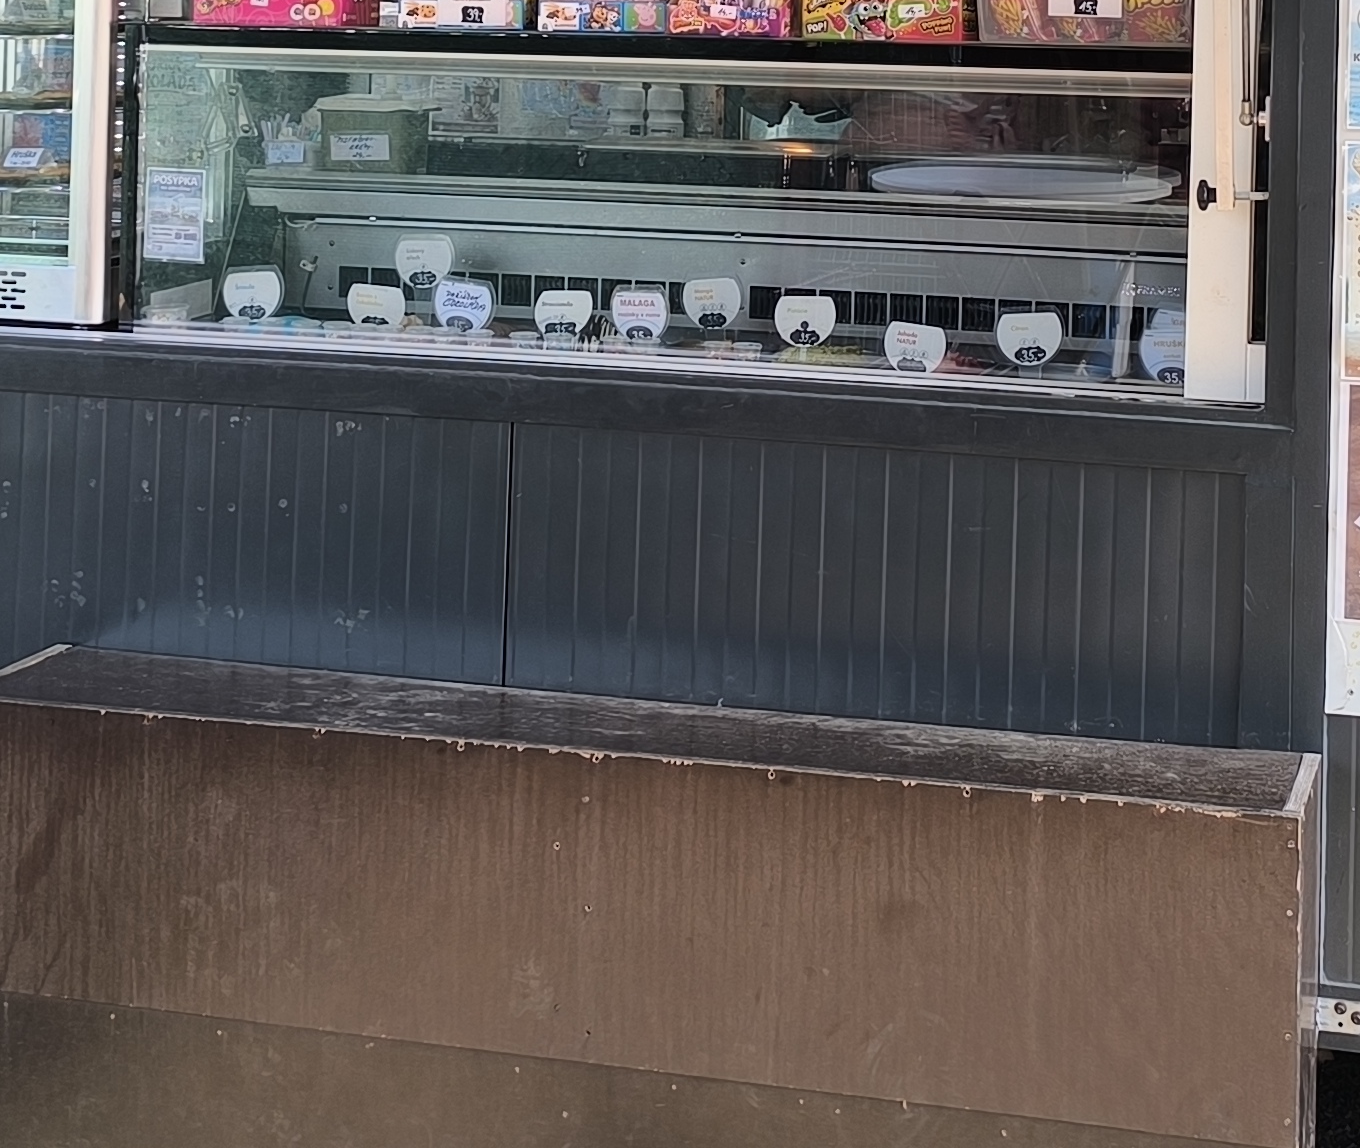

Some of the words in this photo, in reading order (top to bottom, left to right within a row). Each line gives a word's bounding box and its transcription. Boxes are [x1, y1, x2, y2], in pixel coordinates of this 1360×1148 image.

[806, 21, 828, 33] POP!
[153, 174, 198, 186] POSYPKA
[620, 299, 655, 307] MALAGA
